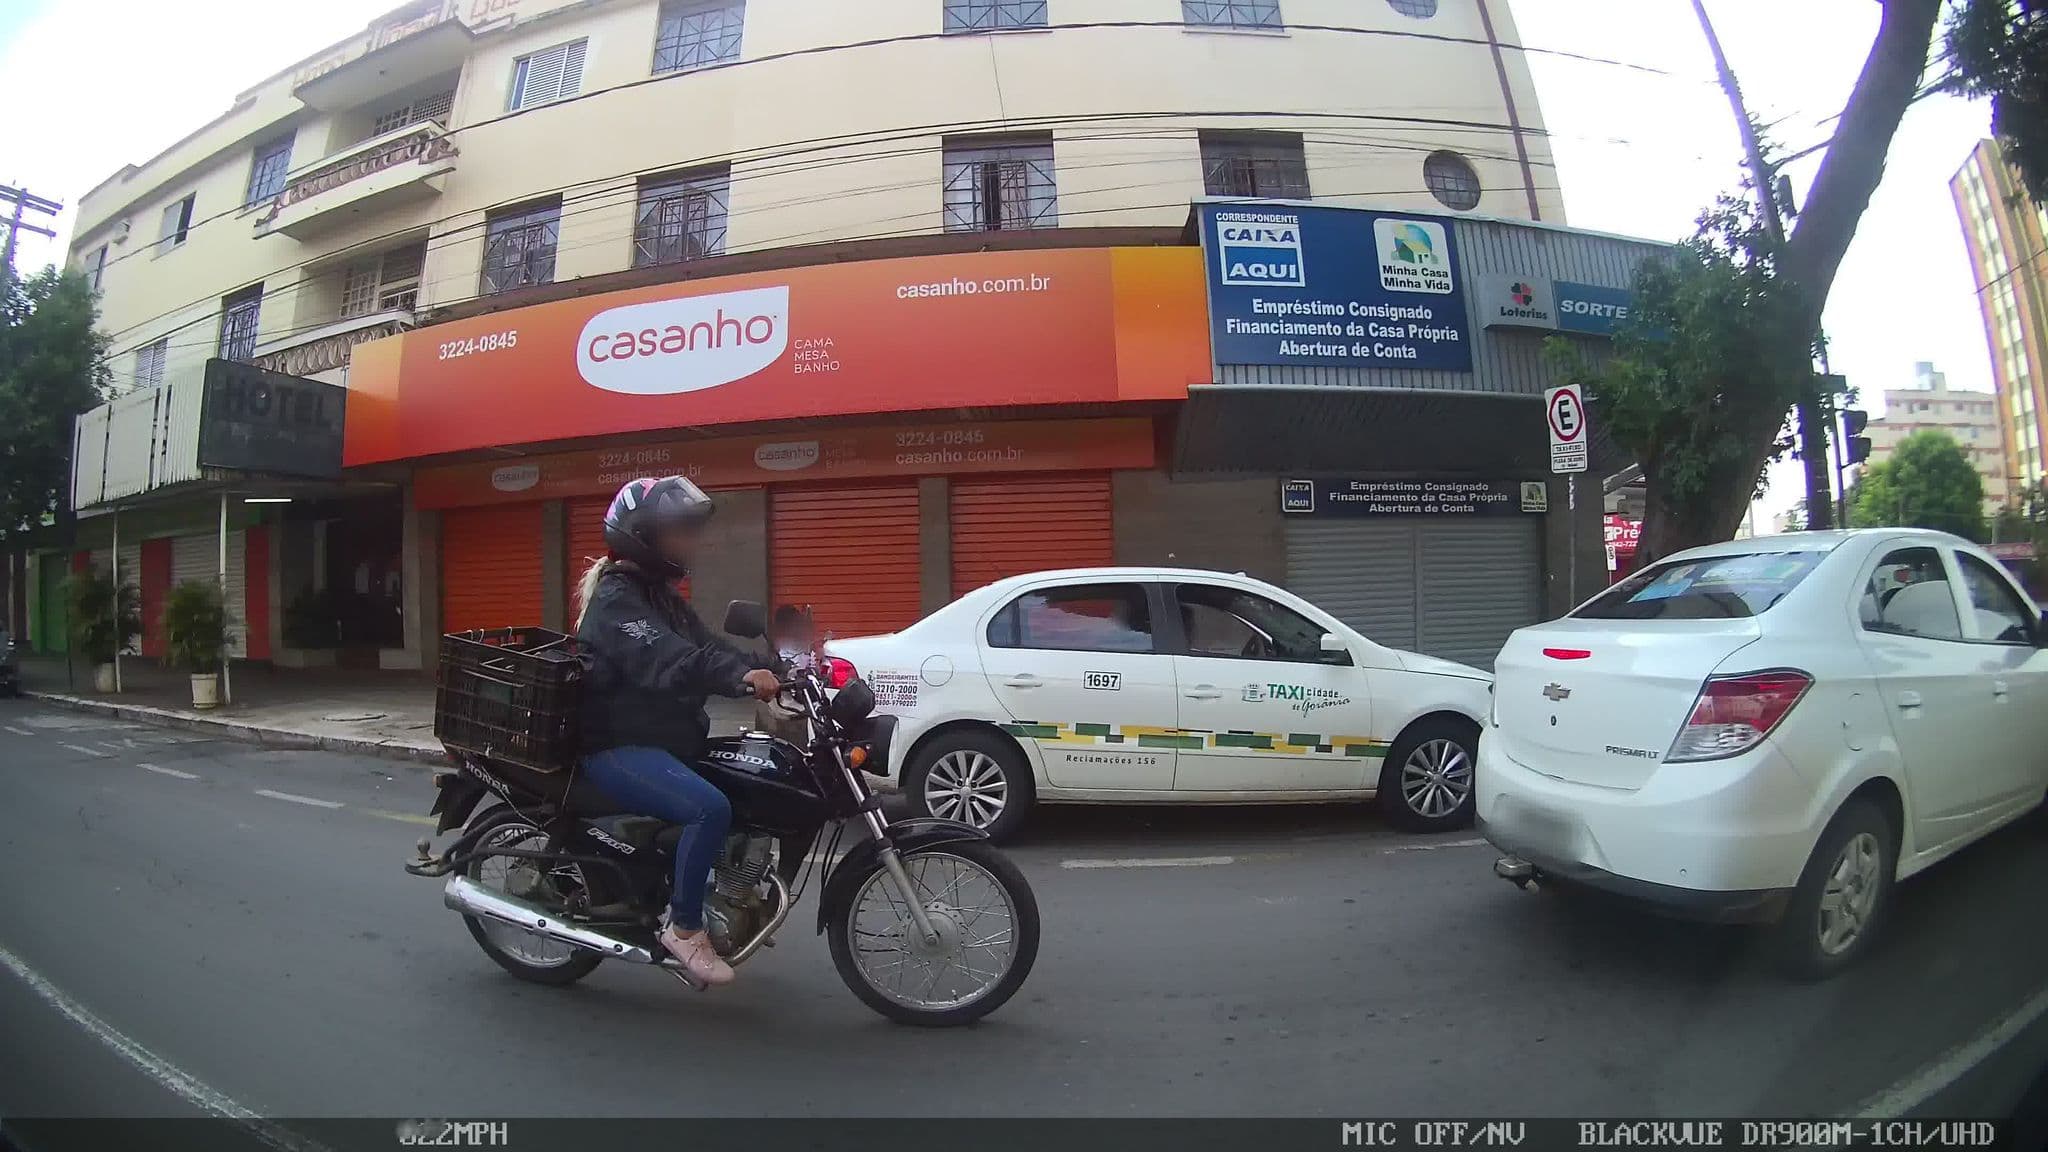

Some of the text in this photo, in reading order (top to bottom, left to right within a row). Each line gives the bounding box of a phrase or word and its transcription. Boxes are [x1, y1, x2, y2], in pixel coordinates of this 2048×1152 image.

[1216, 212, 1299, 224] CORRESPONDENTE
[1223, 228, 1296, 243] CAIXA
[1229, 263, 1297, 279] AQUI
[1382, 265, 1449, 278] Minha Casa
[896, 273, 1051, 299] casanho.com.br
[1384, 277, 1450, 291] Minha Vida
[1252, 299, 1433, 322] Empréstimo Consignado
[1500, 306, 1548, 320] Loterias
[1560, 299, 1628, 319] SORTE
[588, 308, 774, 363] casanho
[1226, 318, 1459, 343] Financiamento da Casa Própria
[438, 330, 519, 361] 3224-0845
[793, 338, 834, 350] CAMA
[1279, 340, 1417, 360] Abertura de Conta
[793, 349, 830, 362] MESA
[793, 360, 840, 374] BANHO
[1558, 399, 1574, 431] E
[896, 430, 984, 447] 3224-0845
[896, 446, 1025, 465] casanho.com.br
[1350, 481, 1489, 493] Empréstimo Consignado
[1329, 492, 1508, 504] Financiamento da Casa Própria
[1369, 503, 1475, 513] Abertura de Conta
[1613, 527, 1640, 540] Pre
[1087, 674, 1118, 688] 1697
[876, 685, 918, 694] 3210-2000
[1267, 683, 1339, 700] TAXI cidade
[1605, 745, 1659, 759] PRISMA LT
[708, 750, 777, 771] HONDA
[1137, 757, 1156, 765] 156
[465, 760, 510, 794] HONDA
